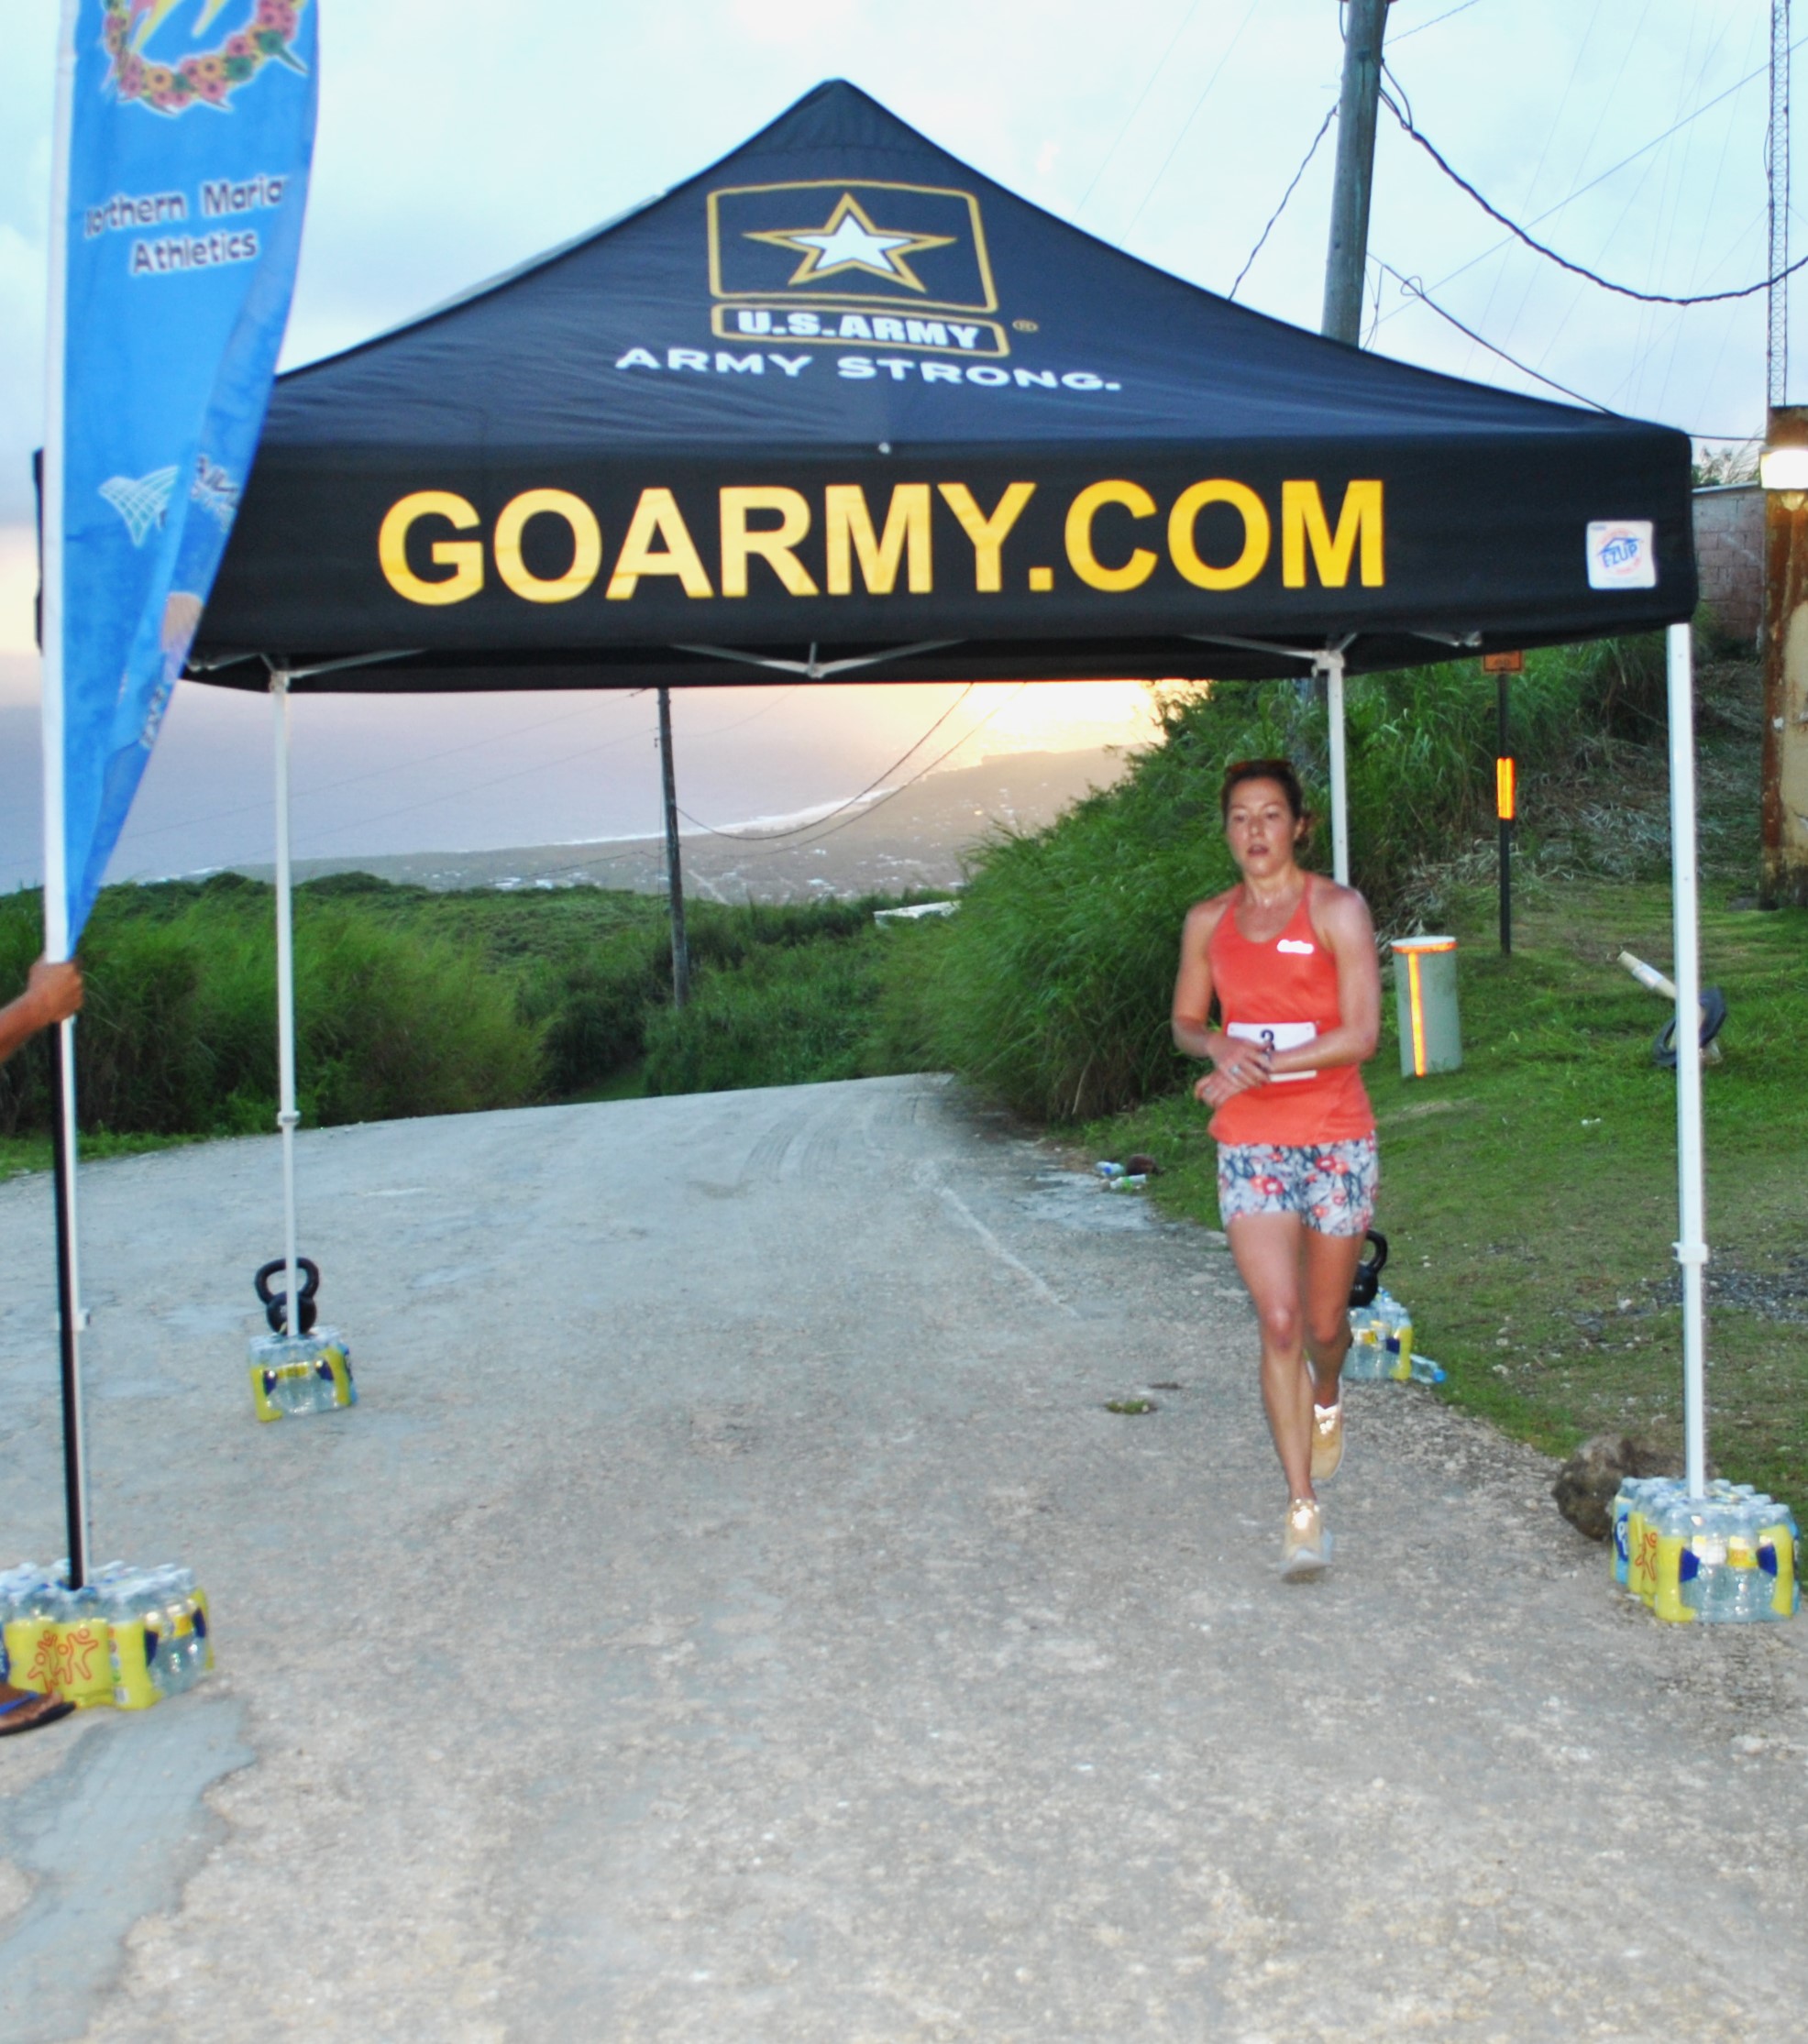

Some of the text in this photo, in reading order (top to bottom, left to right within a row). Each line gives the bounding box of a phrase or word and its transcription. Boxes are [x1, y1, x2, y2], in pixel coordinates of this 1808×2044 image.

[134, 231, 257, 274] Athletics
[737, 309, 979, 349] U.S.ARMY
[615, 347, 1121, 390] ARMY STRONG.
[378, 478, 1384, 605] GOARMY.COM
